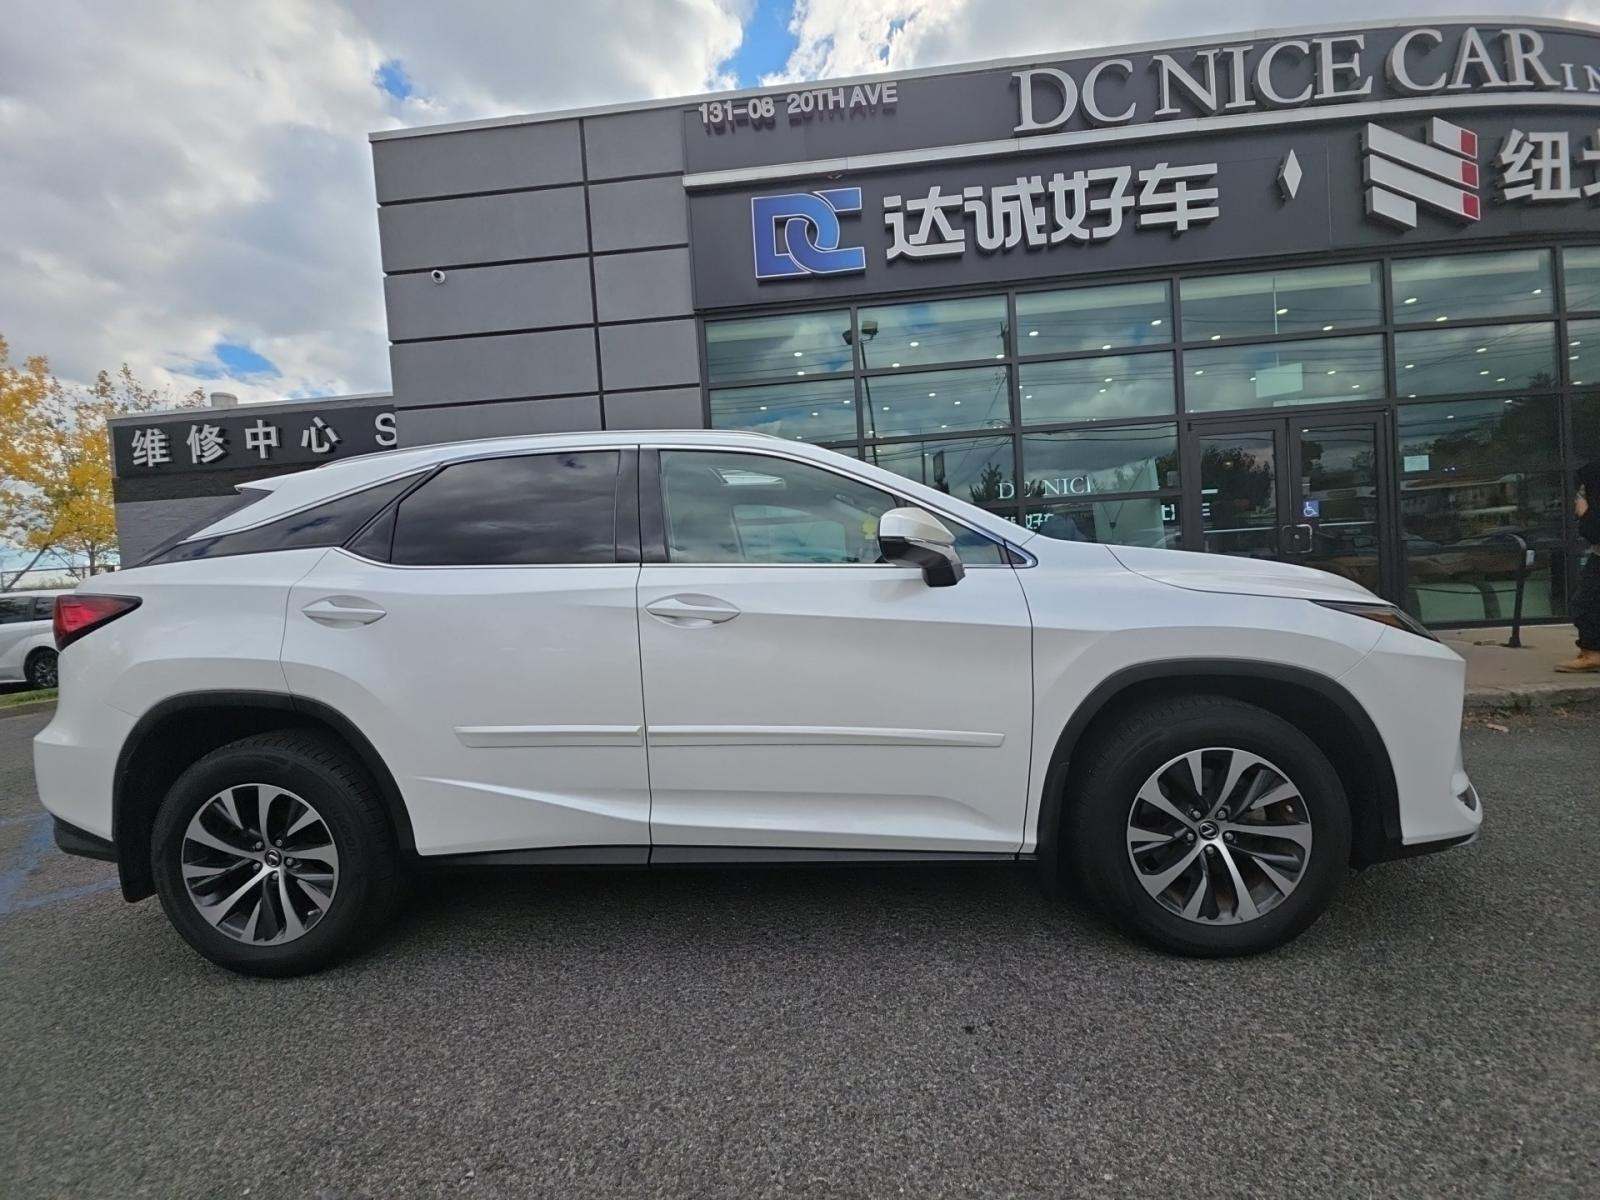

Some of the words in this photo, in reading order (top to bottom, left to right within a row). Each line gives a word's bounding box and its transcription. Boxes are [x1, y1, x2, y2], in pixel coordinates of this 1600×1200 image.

[699, 97, 776, 124] 131-08
[787, 87, 845, 114] 20TH
[850, 82, 898, 108] AVE
[1011, 59, 1137, 132] DC
[1153, 34, 1372, 116] NICE
[1390, 26, 1562, 91] CAR
[1501, 128, 1600, 201] 纽
[884, 162, 1220, 261] 达诚好车
[131, 416, 342, 467] 维修中心
